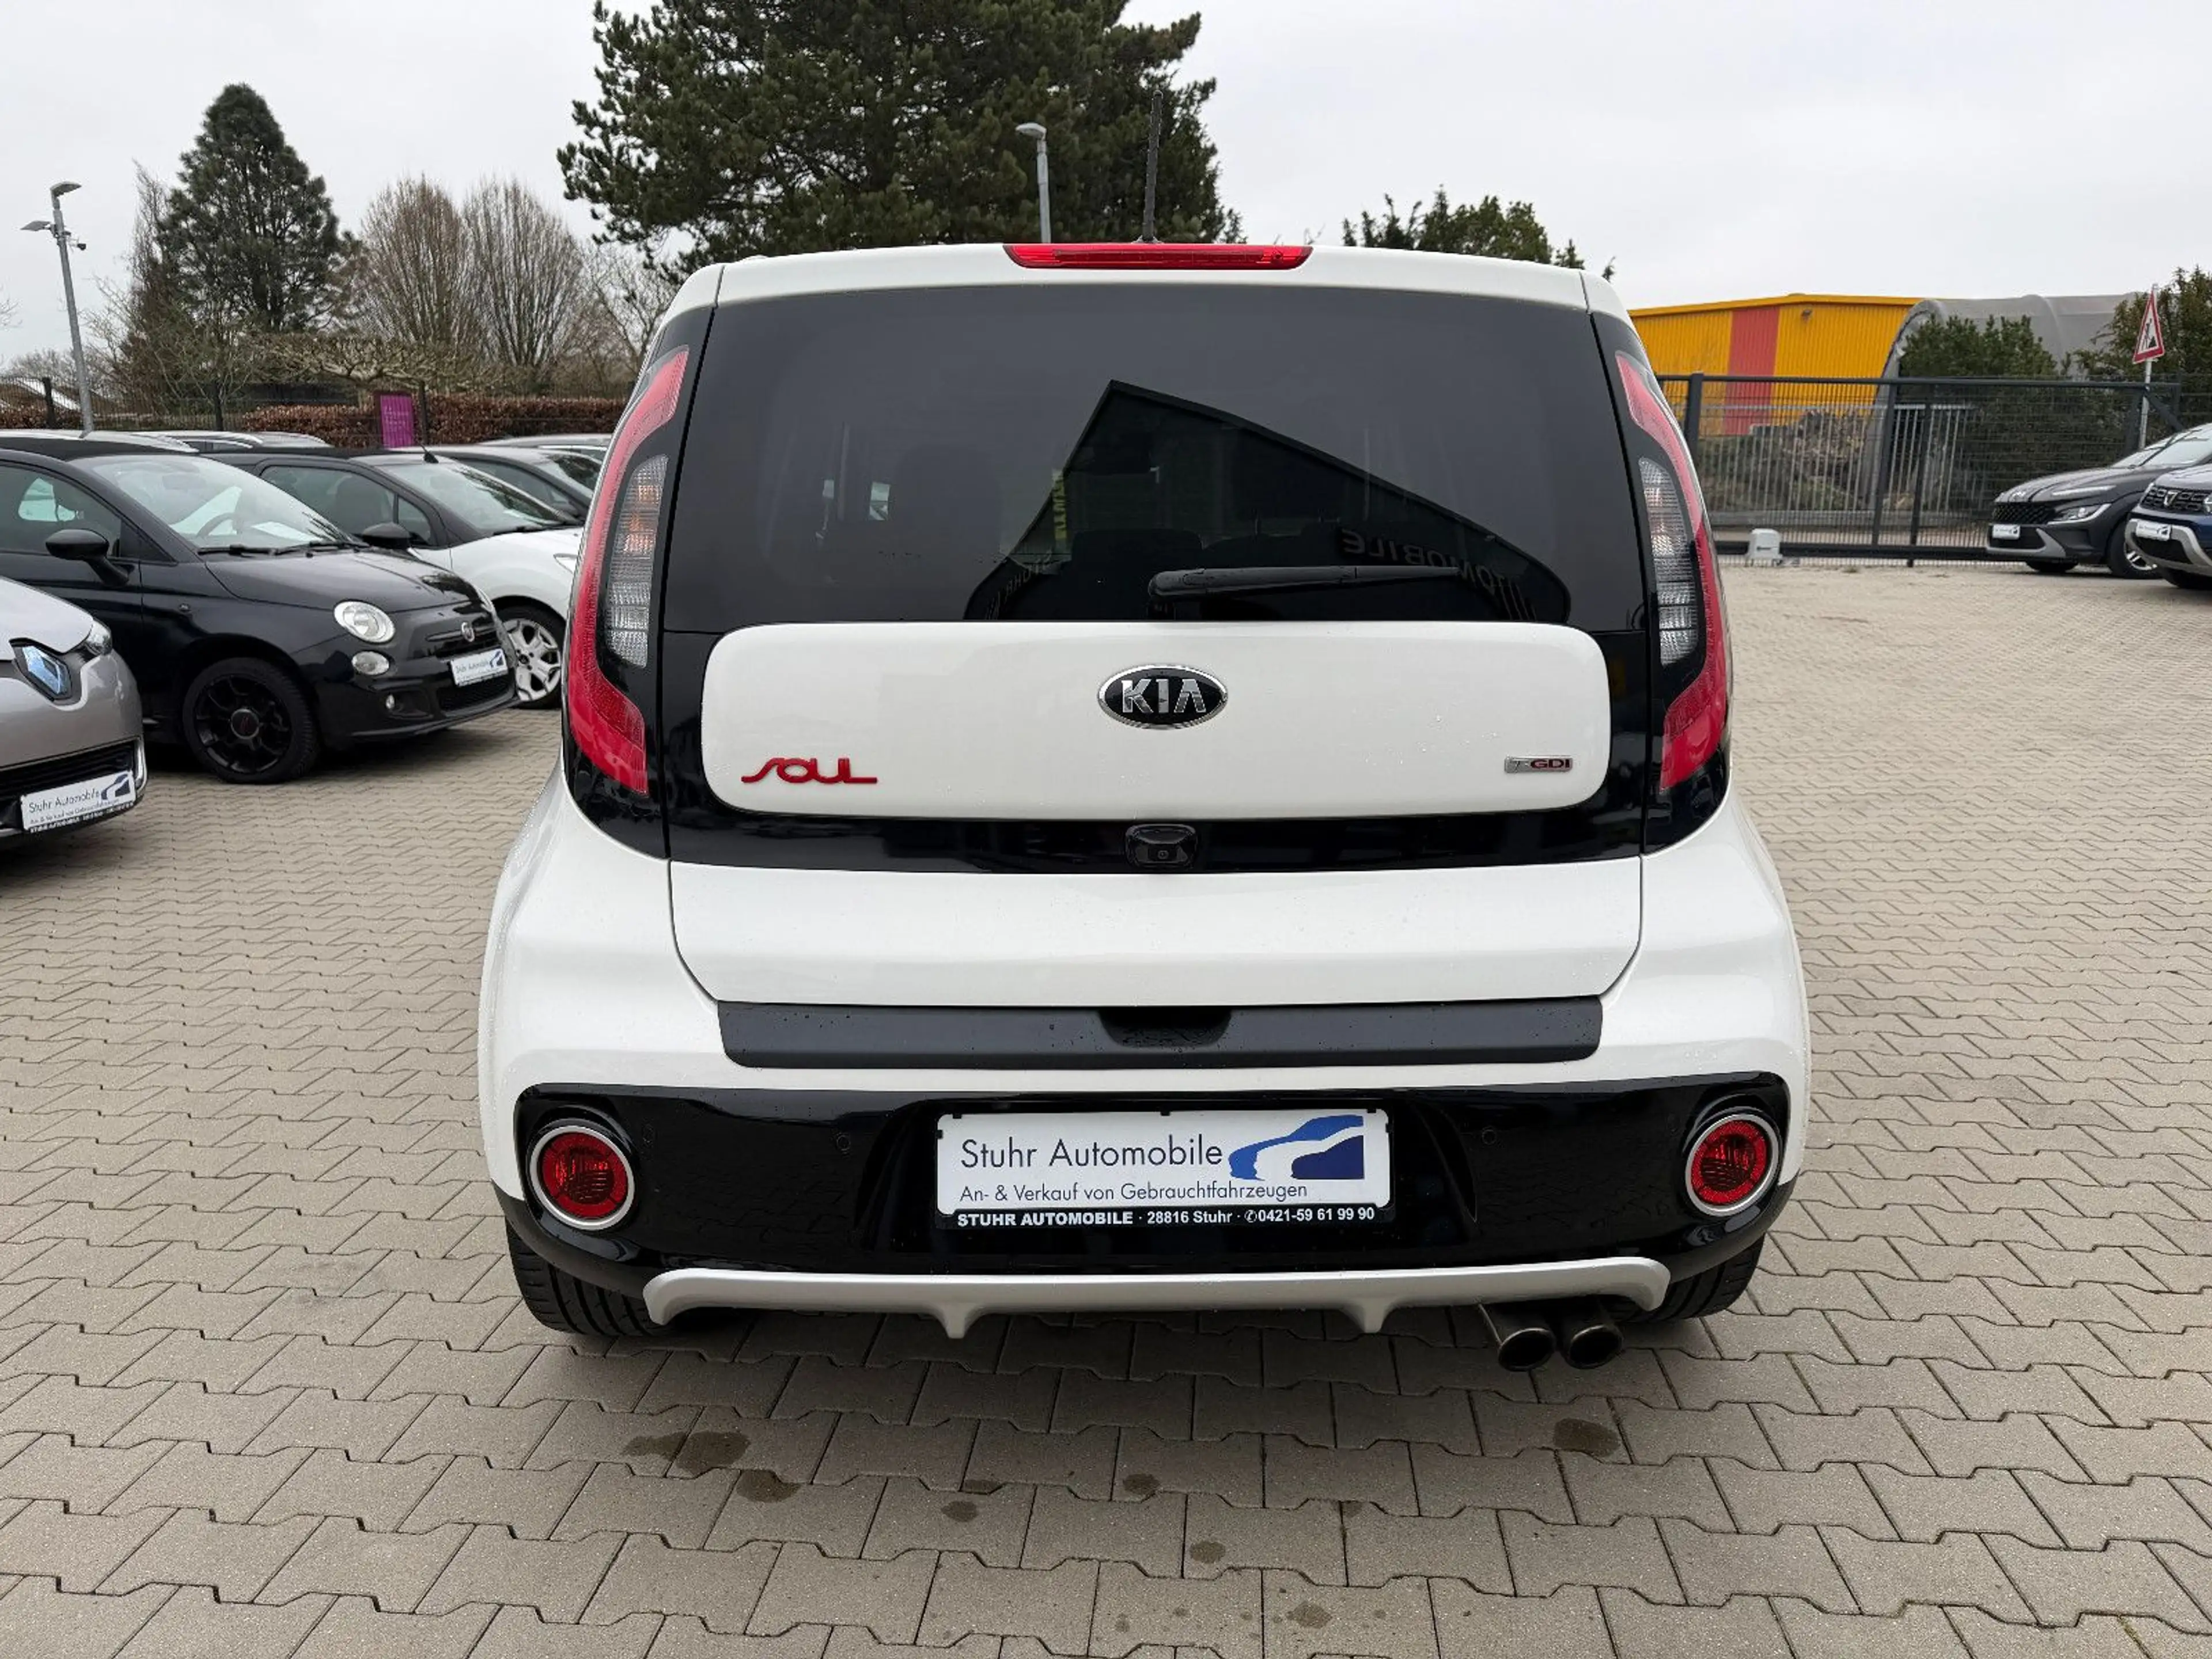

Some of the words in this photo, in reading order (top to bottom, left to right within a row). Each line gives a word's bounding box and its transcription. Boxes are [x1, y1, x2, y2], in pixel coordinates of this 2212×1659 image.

[1122, 678, 1206, 713] KIA
[741, 757, 877, 784] SOUL
[29, 800, 52, 813] Stuhr
[55, 787, 100, 806] Automobile
[961, 1136, 1037, 1168] Stuhr
[1049, 1134, 1223, 1166] Automobile
[960, 1185, 989, 1202] An-
[995, 1184, 1008, 1201] &
[1014, 1182, 1078, 1201] Verkauf
[1084, 1188, 1114, 1200] von
[1120, 1181, 1307, 1202] Gebrauchtfahrzeugen
[957, 1213, 1017, 1226] STUHR
[1020, 1211, 1133, 1226] AUTOMOBILE
[1147, 1210, 1189, 1224] 28816
[1192, 1210, 1233, 1224] Stuhr
[1317, 1209, 1333, 1221] 61
[1338, 1208, 1354, 1221] 99
[1358, 1207, 1375, 1220] 90
